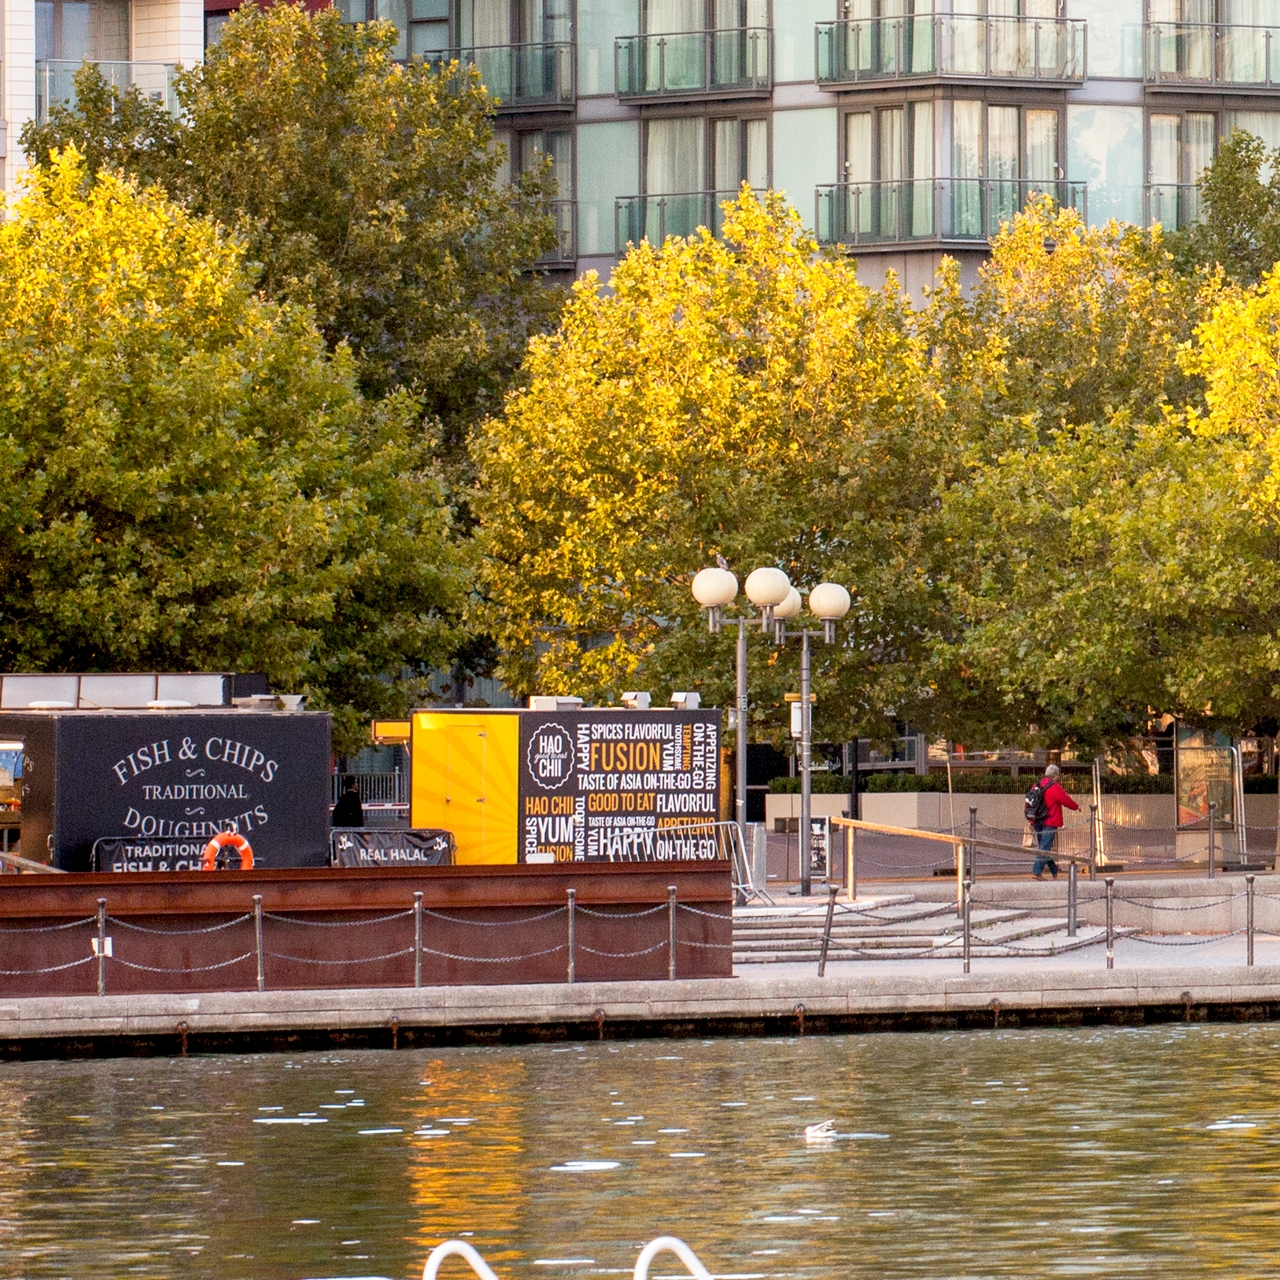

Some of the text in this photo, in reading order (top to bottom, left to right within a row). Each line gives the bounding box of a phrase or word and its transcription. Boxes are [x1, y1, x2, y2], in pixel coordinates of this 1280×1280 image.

[591, 723, 674, 740] SPICES FLAVORFUL
[539, 735, 563, 753] HAO
[576, 723, 590, 771] HAPPY
[674, 723, 683, 771] TOOTHSOME
[682, 723, 692, 771] TEMPTING
[112, 736, 279, 786] FISH & CHIPS
[590, 742, 661, 771] FUSION
[662, 742, 674, 771] YUM
[692, 723, 705, 789] ON-THE-GO
[705, 723, 717, 790] APPETIZING
[539, 759, 562, 777] CHII
[142, 784, 248, 800] TRADITIONAL
[577, 773, 692, 790] TASTE OF ASIA ON-THE-GO
[525, 796, 574, 815] HAO CHII
[588, 792, 656, 812] GOOD TO EAT
[656, 793, 716, 813] FLAVORFUL
[123, 804, 269, 837] DOUGHNUTS
[537, 816, 574, 843] YUM
[588, 816, 656, 827] TASTE OF ASIA ON-THE-GO
[657, 817, 716, 835] APPETIZING
[525, 817, 538, 854] SPICE
[587, 828, 599, 856] YUM
[599, 827, 656, 856] HAPPY
[125, 845, 208, 858] TRADITIONA
[359, 849, 428, 861] REAL HALAL
[656, 840, 716, 860] ON-THE-GO
